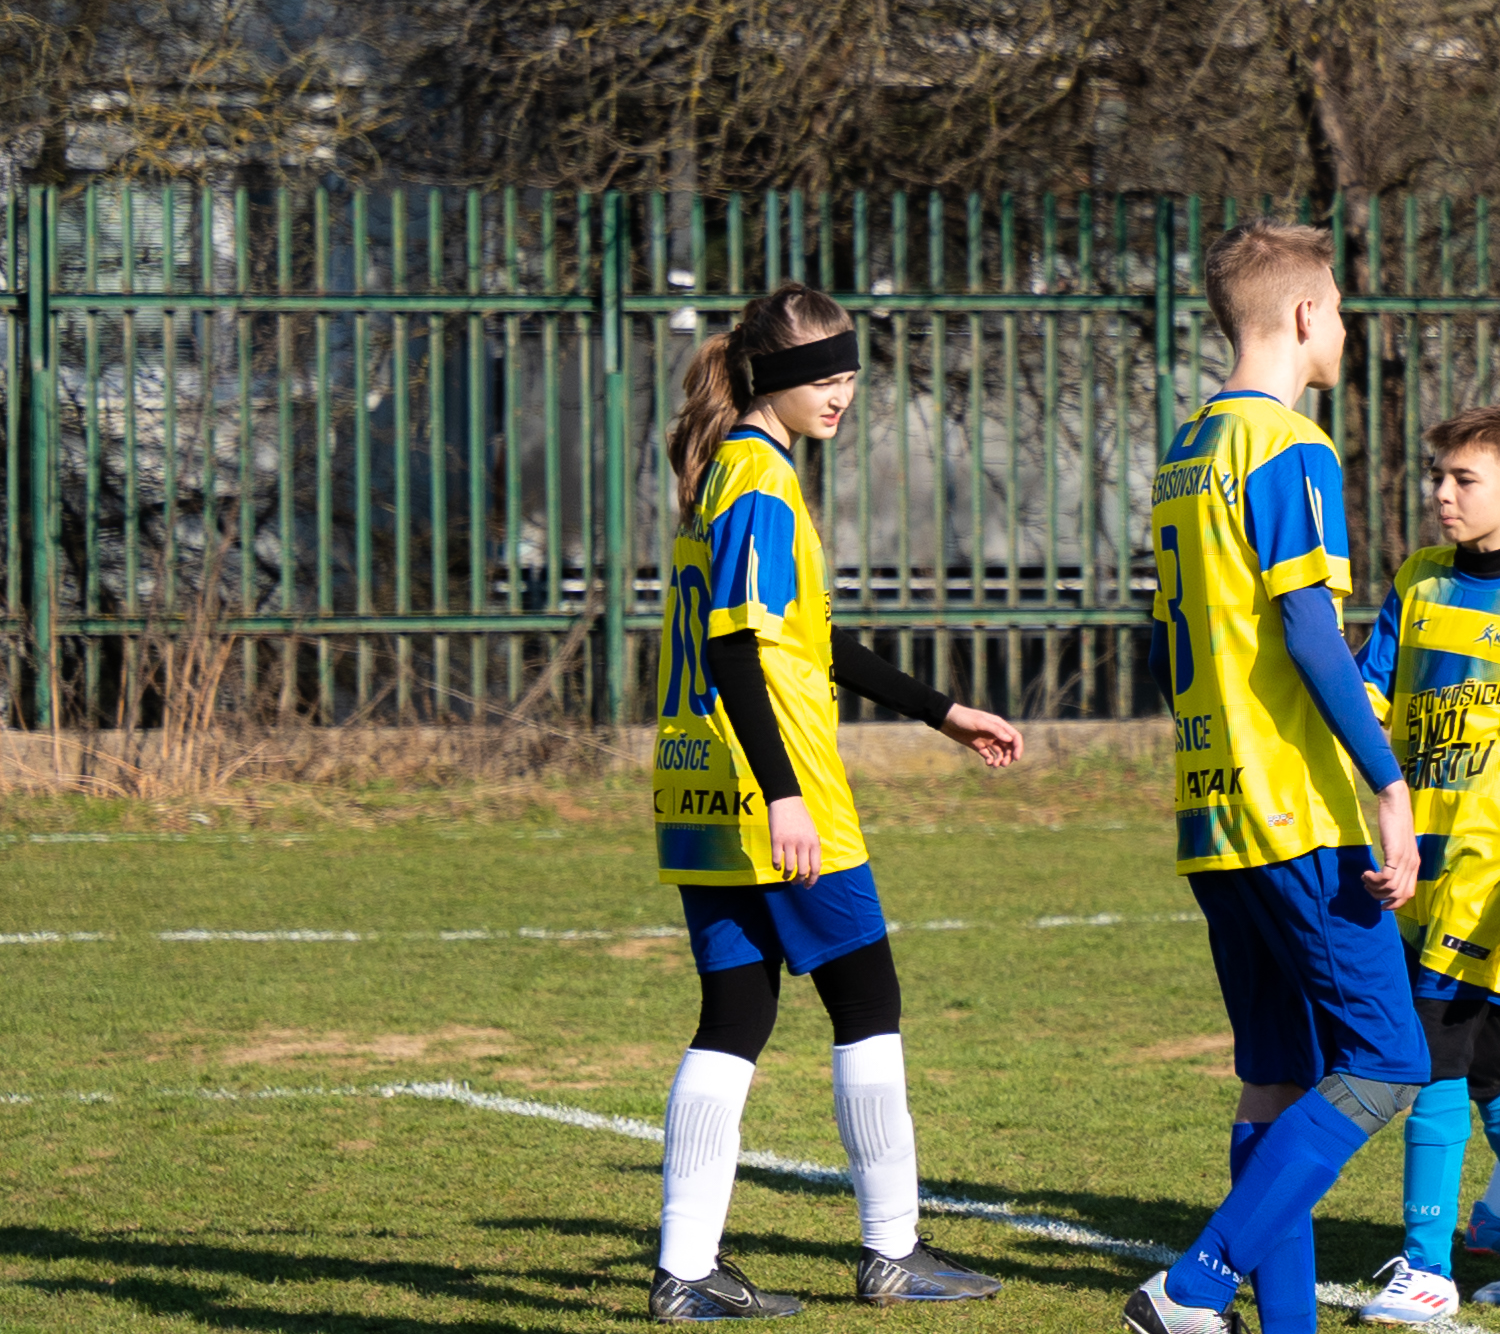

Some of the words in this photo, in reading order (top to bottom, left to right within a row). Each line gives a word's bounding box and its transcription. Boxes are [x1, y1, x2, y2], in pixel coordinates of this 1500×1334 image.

[1160, 524, 1195, 696] 3
[656, 733, 710, 771] KOŠICE
[1187, 767, 1245, 799] ATAK
[680, 789, 757, 816] ATAK
